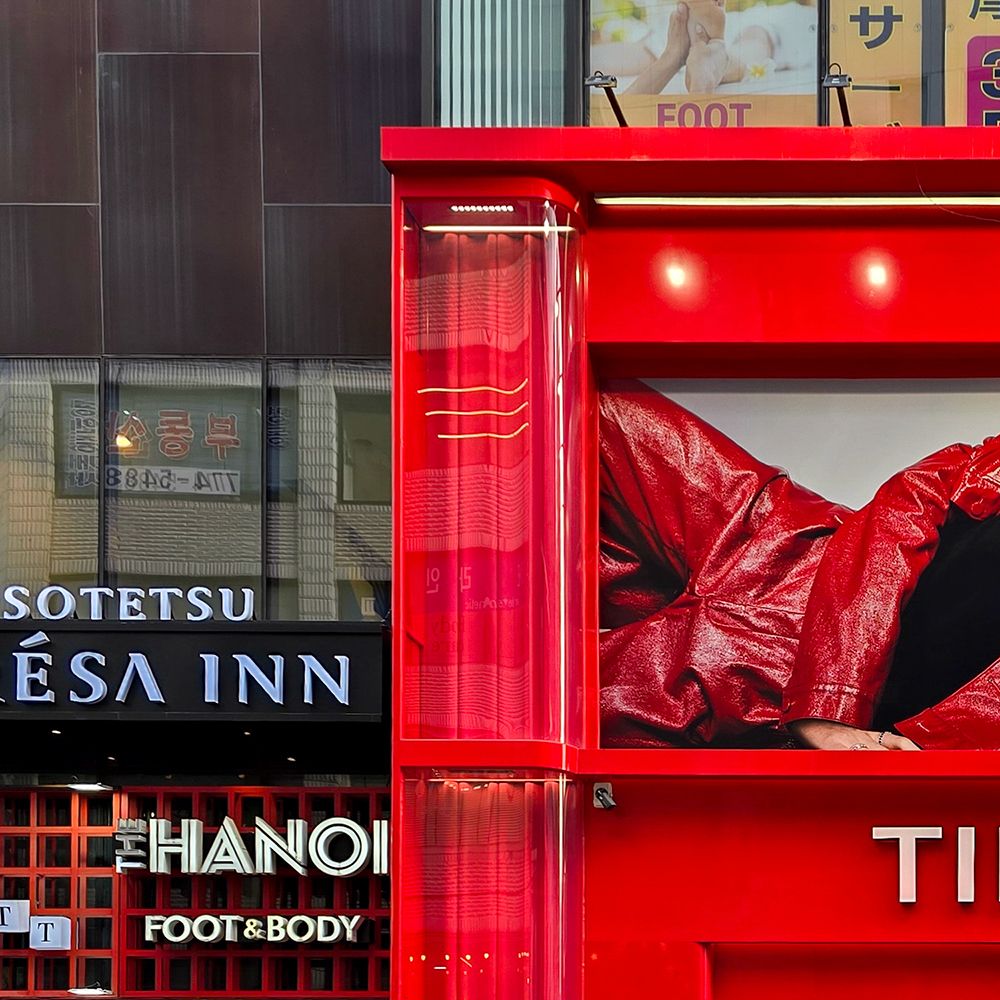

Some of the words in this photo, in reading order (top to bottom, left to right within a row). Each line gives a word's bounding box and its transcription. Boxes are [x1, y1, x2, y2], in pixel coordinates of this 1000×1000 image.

[657, 102, 752, 127] FOOT
[3, 585, 254, 621] SOTETSU
[0, 631, 165, 703] ÉSA
[200, 654, 349, 705] INN
[115, 818, 147, 873] THE
[149, 816, 389, 876] HANOI
[145, 915, 361, 943] FOOT&BODY
